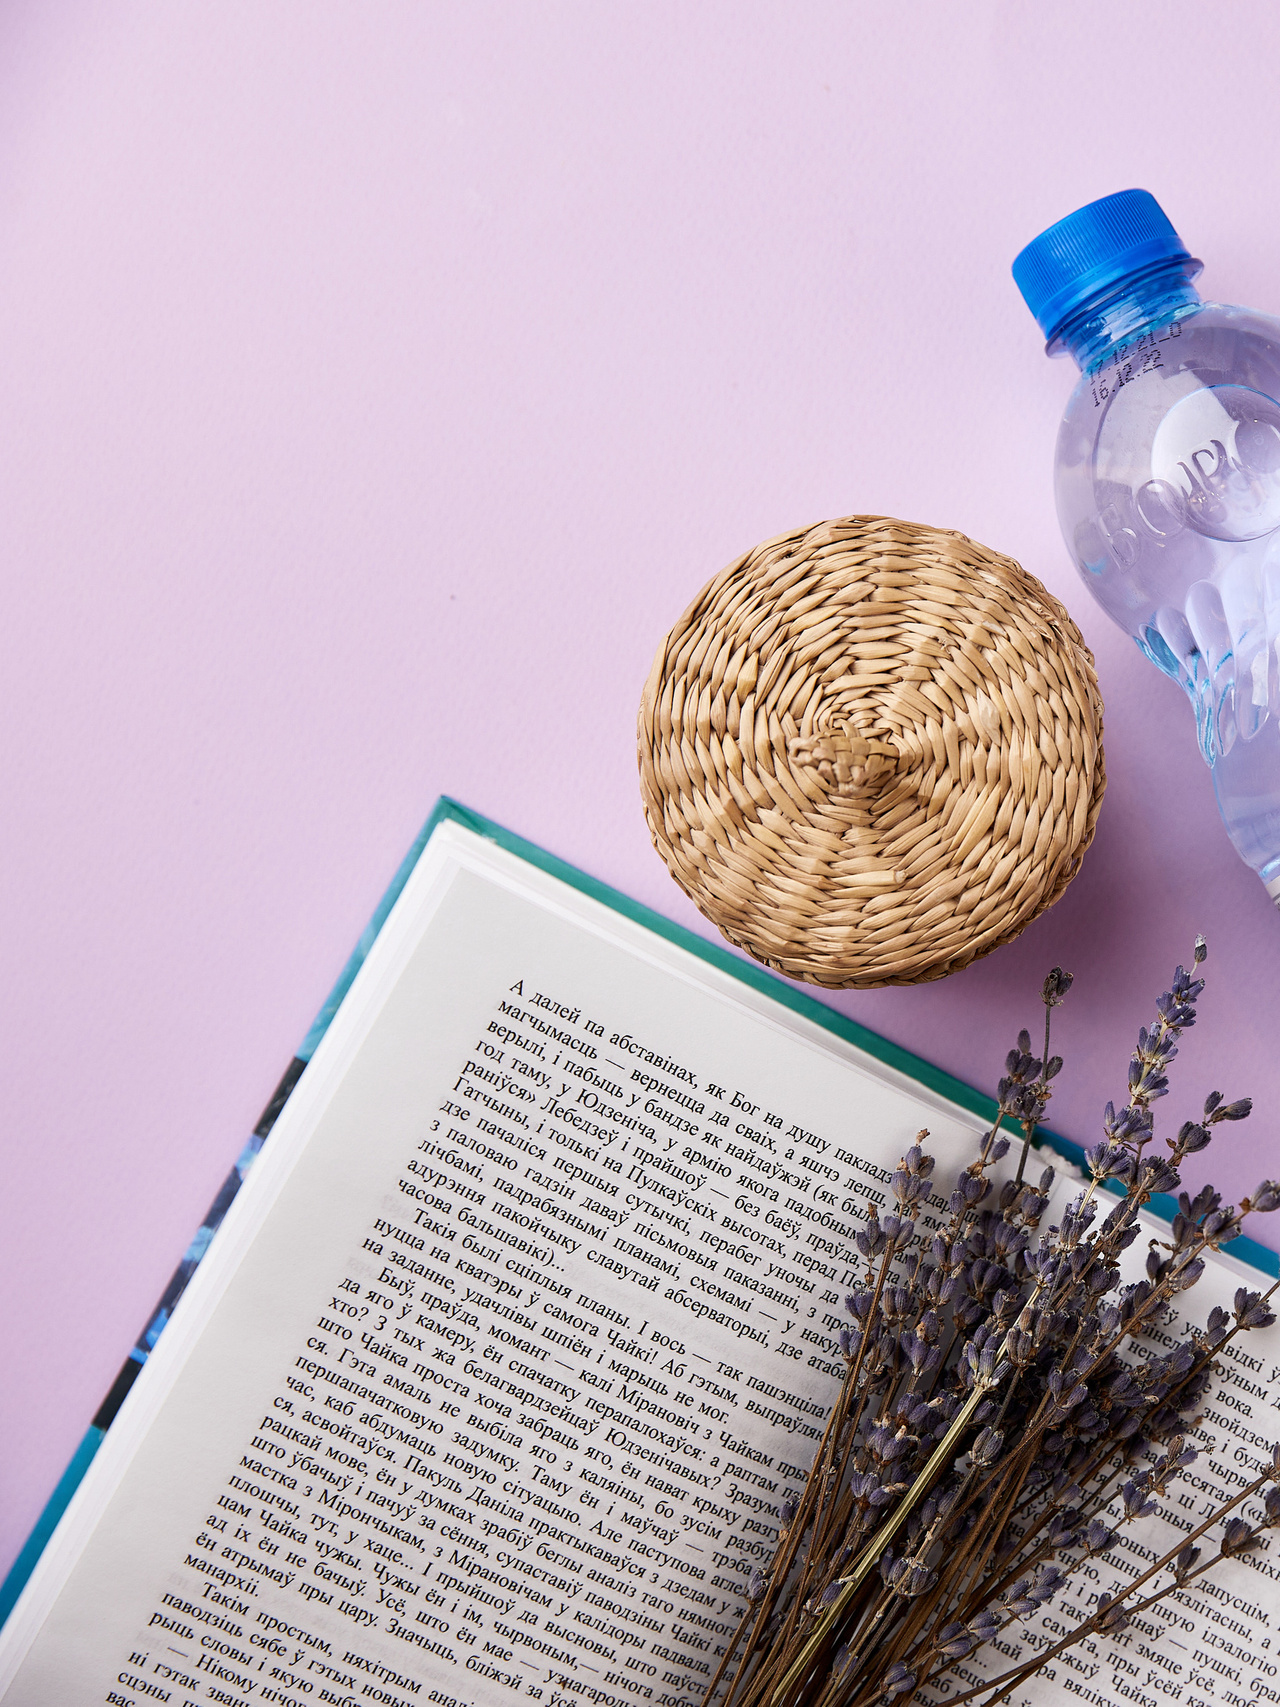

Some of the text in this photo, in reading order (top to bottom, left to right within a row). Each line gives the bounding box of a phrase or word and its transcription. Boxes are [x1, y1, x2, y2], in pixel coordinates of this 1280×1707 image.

[475, 1040, 779, 1202] год таму, у Юдзеніча, у армію якога
[509, 980, 893, 1183] А далей па абставінах, як Бог на душу пакладз
[407, 1160, 803, 1360] адурэння пакойчыку славутай абсерваторыі, дзе
[439, 1101, 839, 1304] дзе пачаліся першыя сутычкі, перабег уночы да
[373, 1218, 738, 1407] нуцца на кватэры ў самога Чайкі! Аб гэтым,
[307, 1337, 722, 1539] ся. Гэта амаль не выбіла яго з каляіны, бо зусім
[338, 1278, 778, 1492] да яго ў камеру, ён спачатку перапалохаўся: а раптам
[1215, 1390, 1252, 1418] вока.
[239, 1456, 710, 1677] мастка з Мірончыкам, з Мірановічам у калідоры падвала,
[273, 1397, 730, 1614] ся, асвойтаўся. Пакуль Даніла практыкаваўся з дзедам у
[1177, 1494, 1197, 1510] ці
[148, 1612, 313, 1693] рыць словы і якую
[196, 1532, 543, 1699] ён атрымаў пры цару. Значыць, бліжэй за
[202, 1582, 421, 1693] Такім простым, няхітрым
[1194, 1571, 1269, 1627] дапусцім,
[1202, 1626, 1277, 1676] ідэалогію
[1261, 1638, 1270, 1649] а
[1106, 1648, 1183, 1699] пры ўсёй
[1135, 1643, 1214, 1695] змяце ўсё,
[1192, 1650, 1242, 1685] пушкі,
